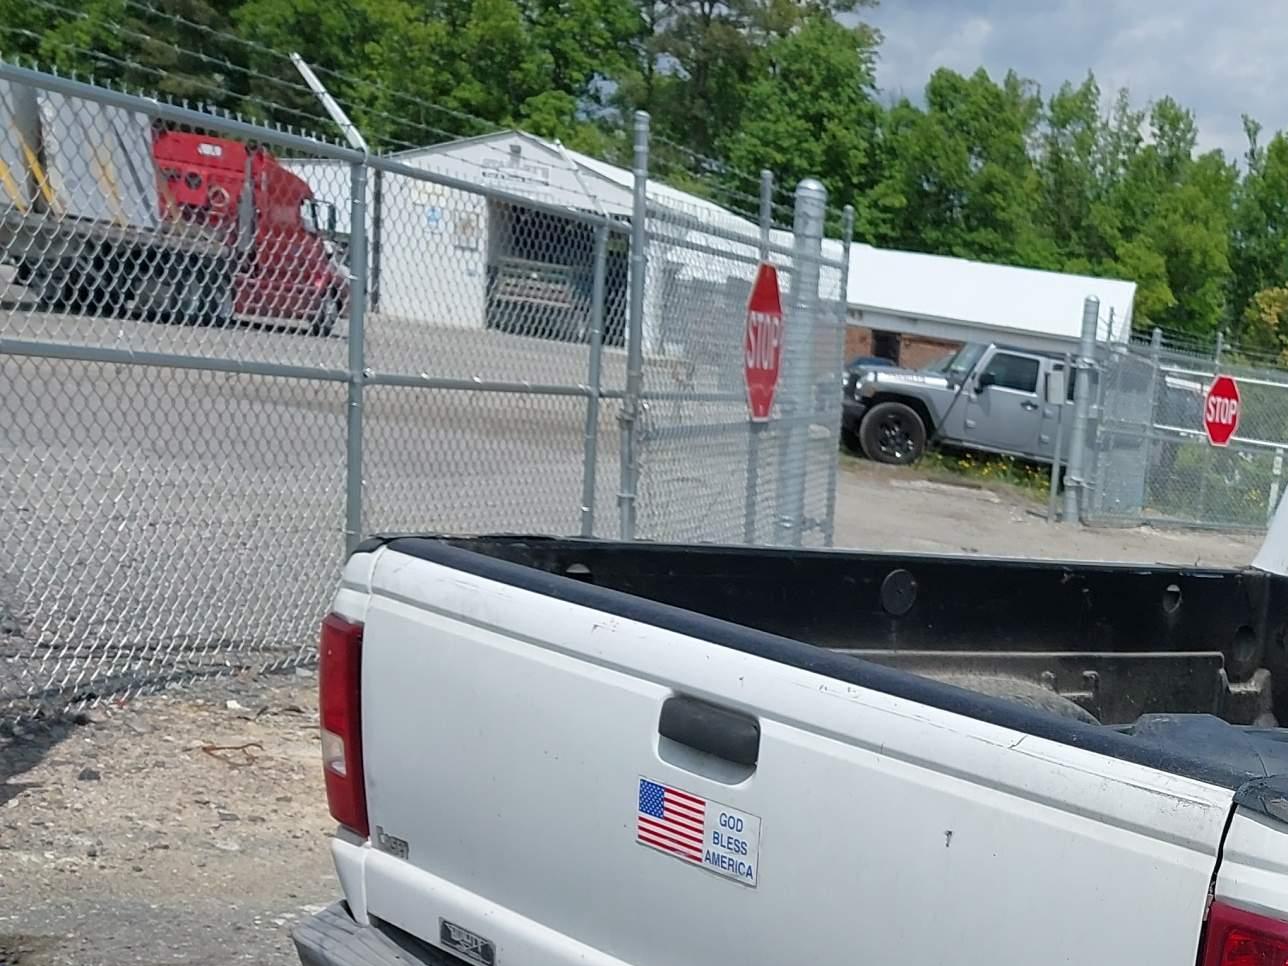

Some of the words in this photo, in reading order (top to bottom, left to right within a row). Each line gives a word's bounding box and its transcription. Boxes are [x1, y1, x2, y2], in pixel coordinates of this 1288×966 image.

[746, 309, 781, 369] STOP
[1206, 395, 1238, 425] STOP
[719, 812, 744, 833] GOD
[712, 830, 748, 856] BLESS
[704, 849, 754, 880] AMERICA
